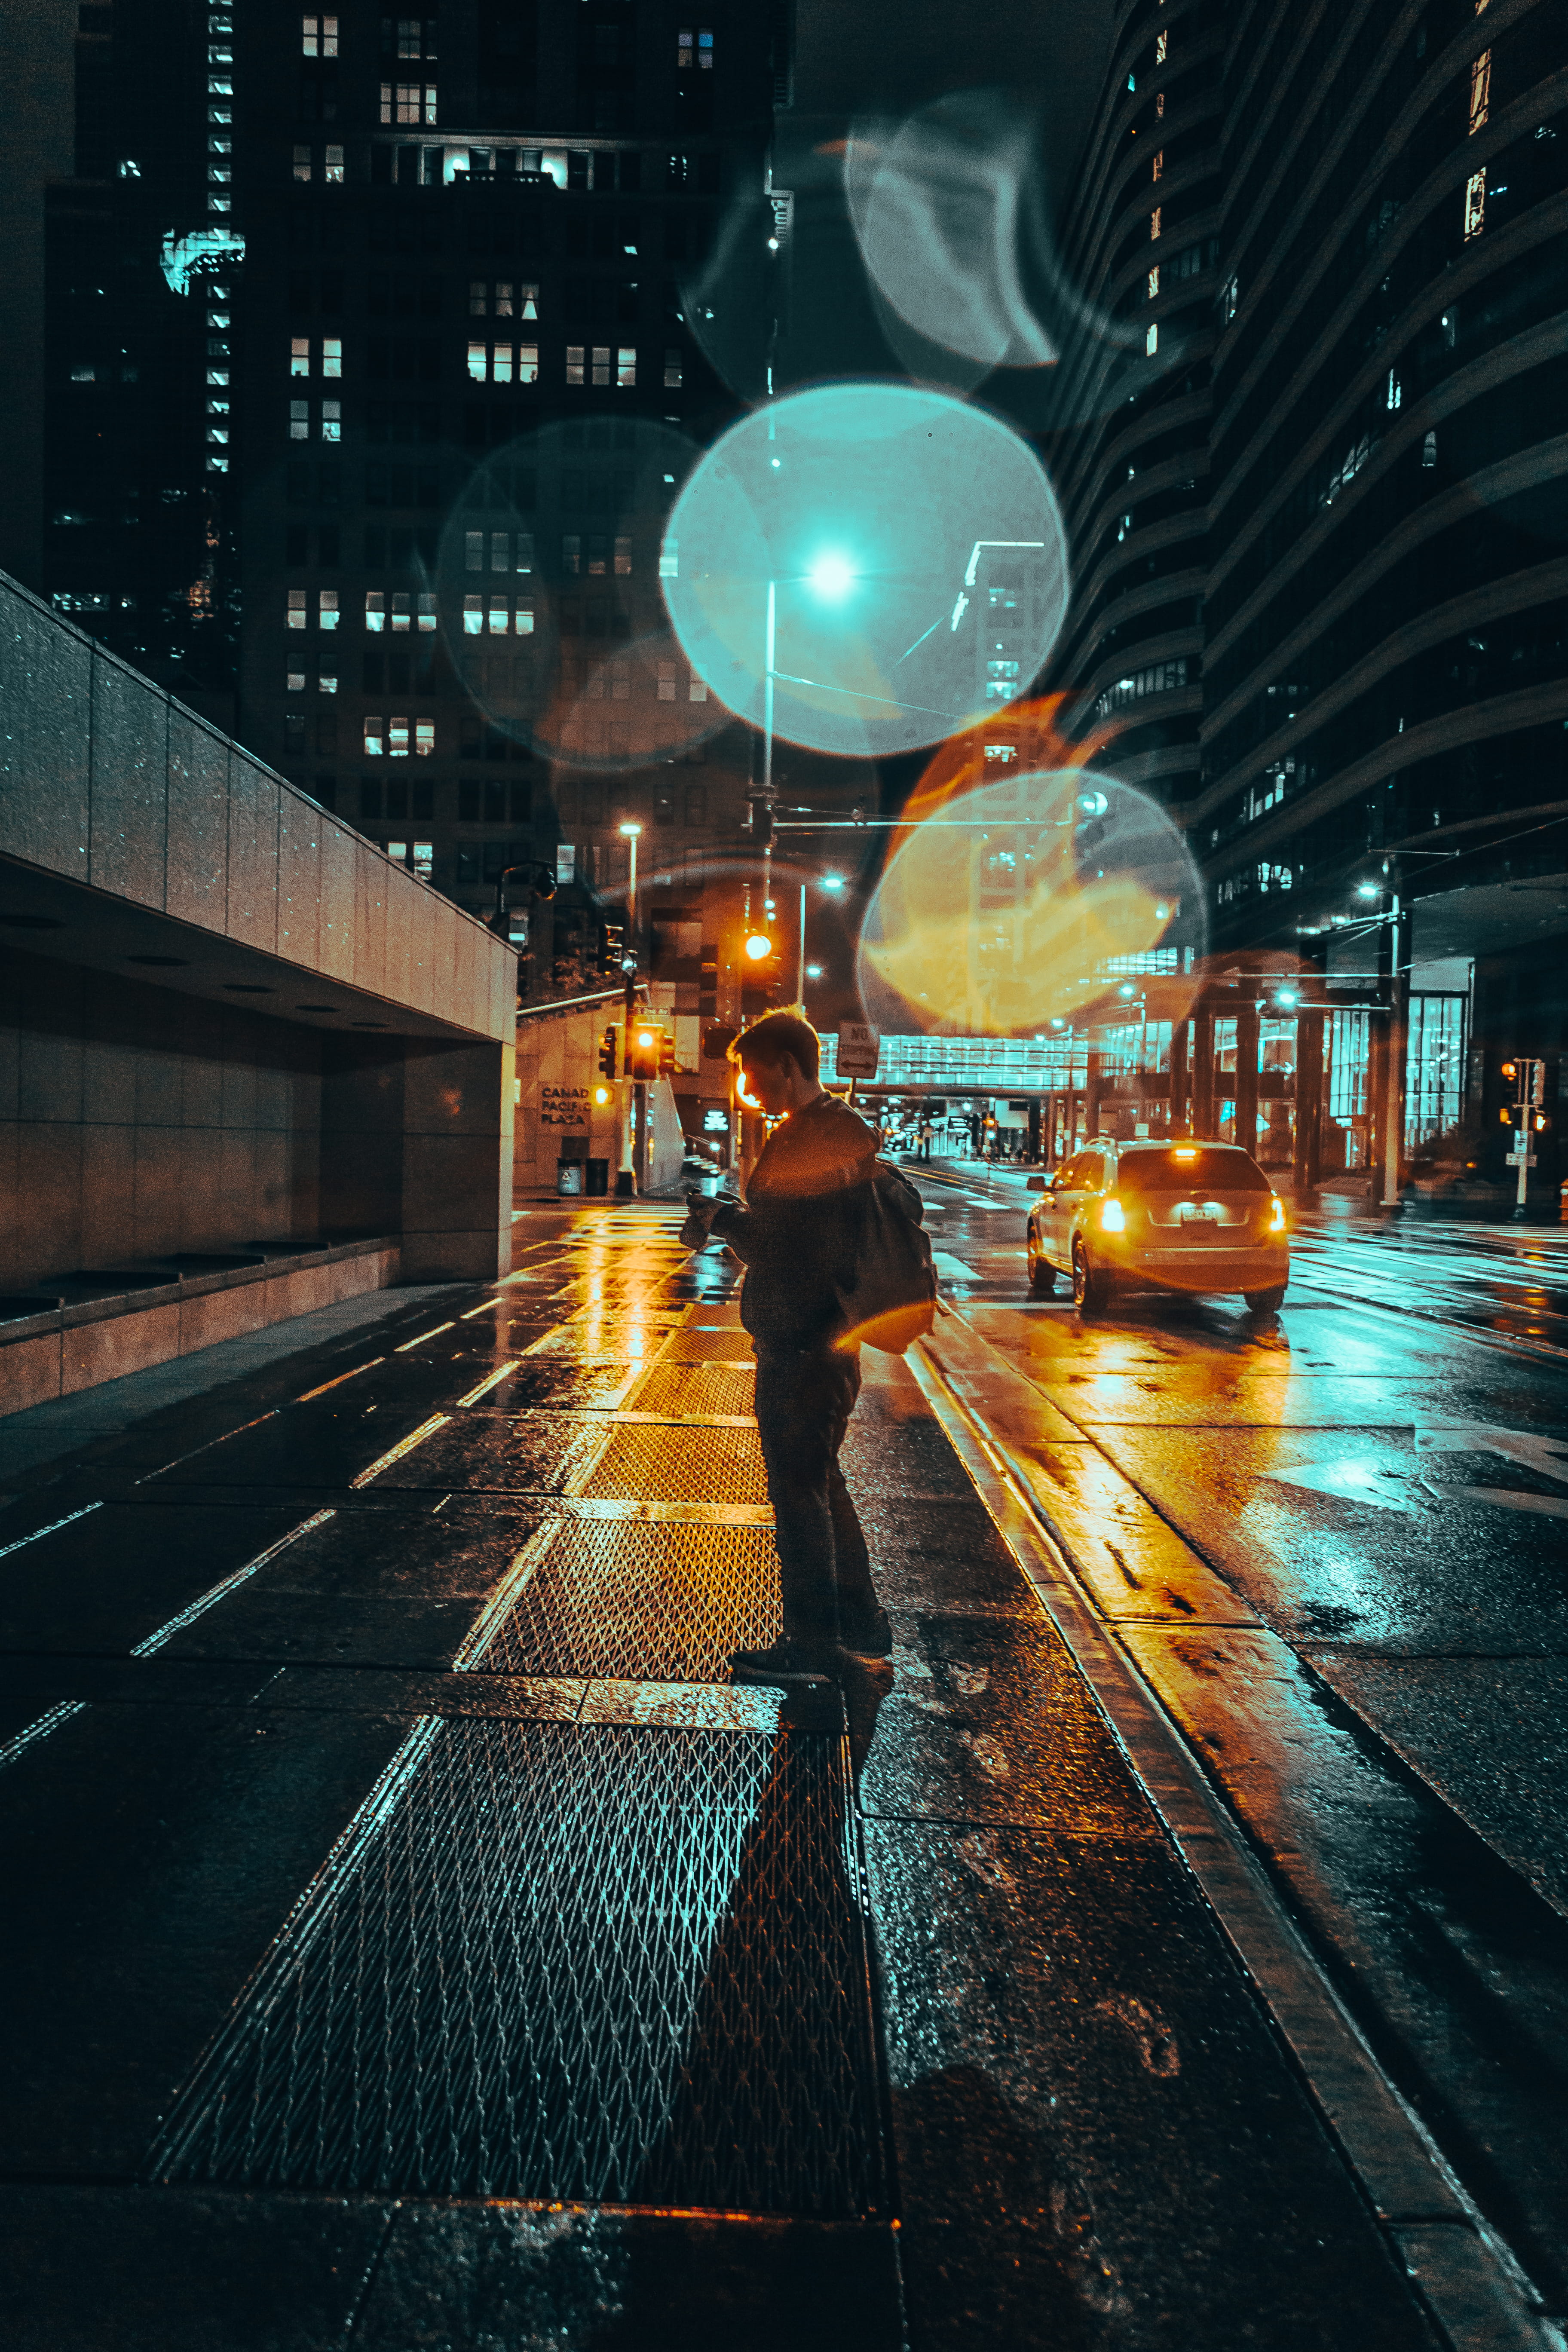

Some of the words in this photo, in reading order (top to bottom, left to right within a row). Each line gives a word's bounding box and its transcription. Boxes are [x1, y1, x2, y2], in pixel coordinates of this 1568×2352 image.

[851, 1027, 868, 1040] NO
[542, 1087, 589, 1098] CANAD
[542, 1100, 591, 1112] PACIFC
[542, 1114, 584, 1124] PLAZA
